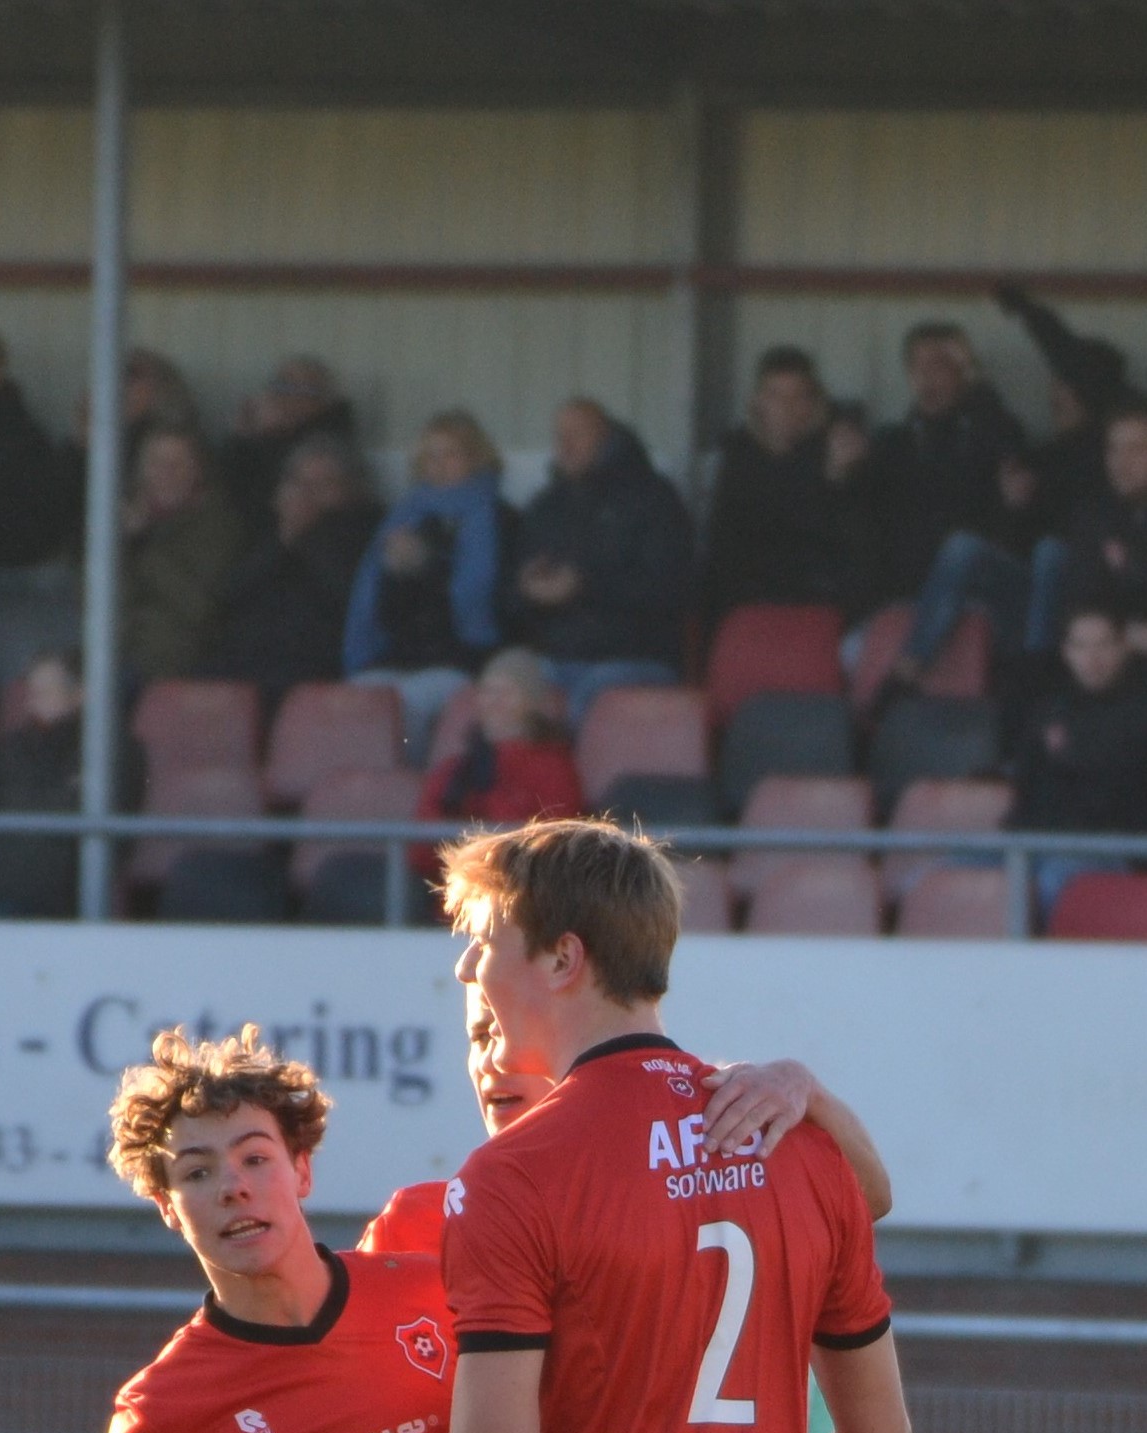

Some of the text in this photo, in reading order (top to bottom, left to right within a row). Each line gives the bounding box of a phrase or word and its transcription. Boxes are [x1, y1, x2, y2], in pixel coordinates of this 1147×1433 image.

[75, 993, 433, 1104] Ctring
[649, 1112, 763, 1170] AFS
[666, 1161, 765, 1200] sotware
[687, 1220, 755, 1425] 2
